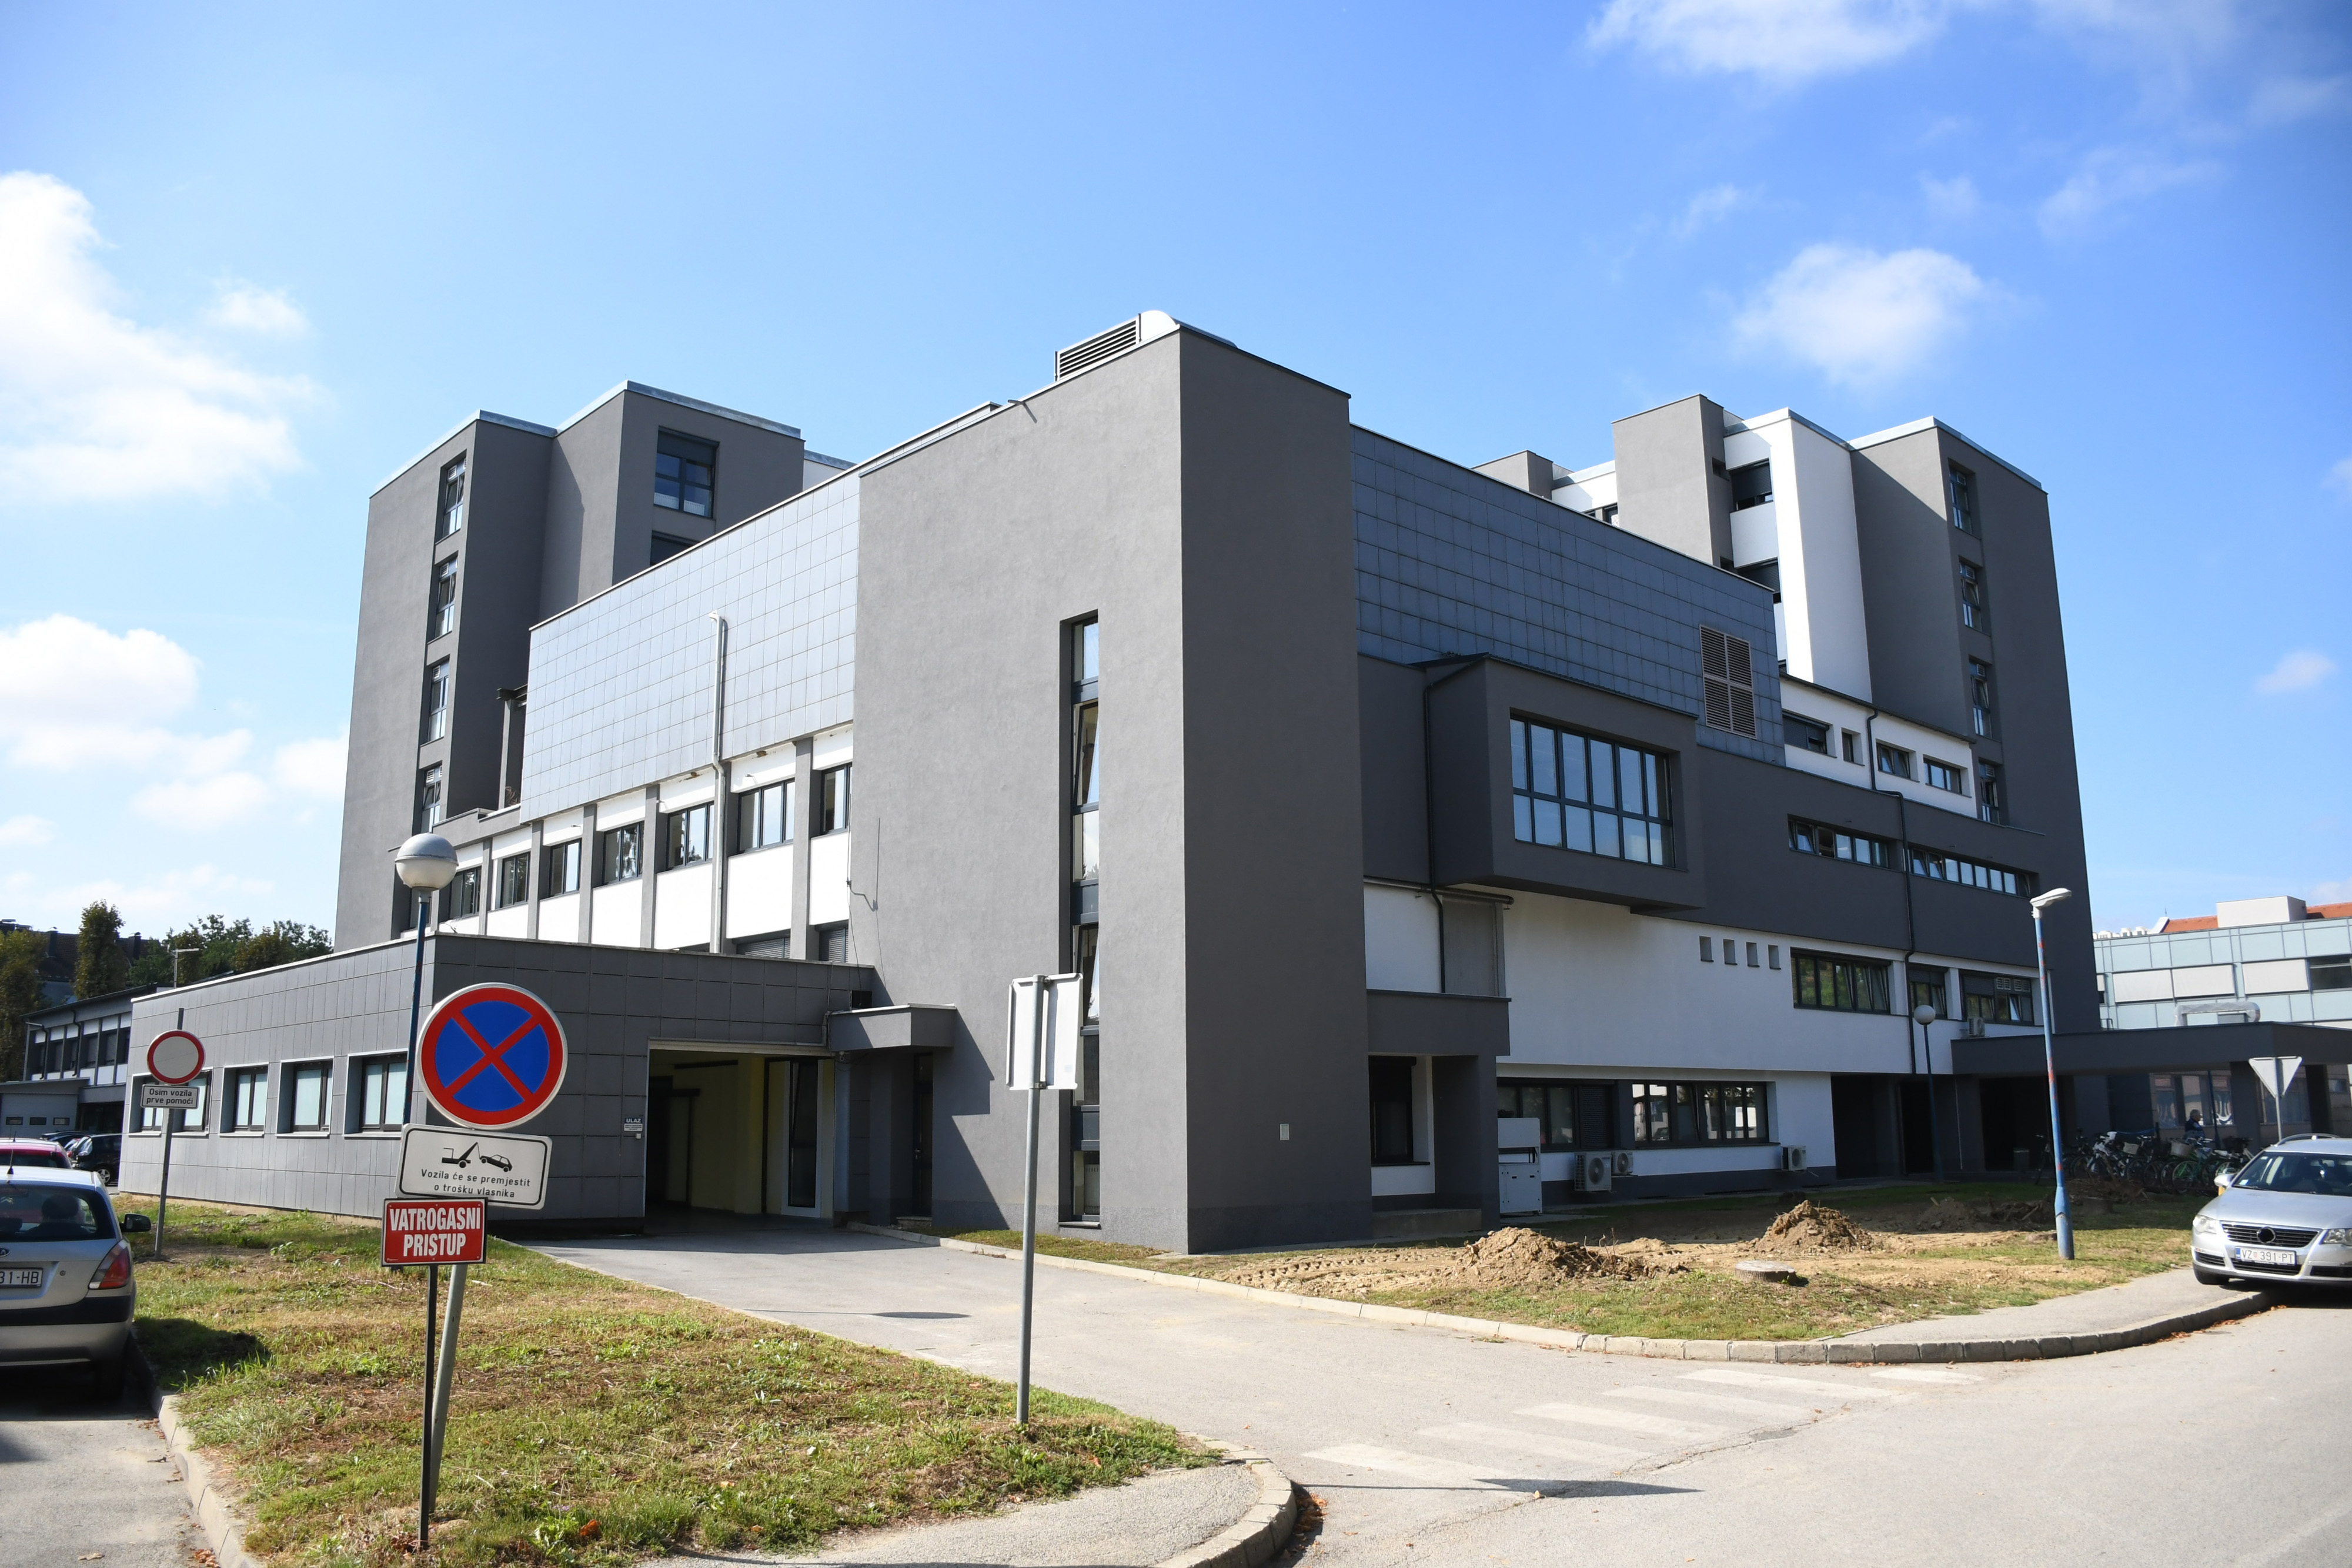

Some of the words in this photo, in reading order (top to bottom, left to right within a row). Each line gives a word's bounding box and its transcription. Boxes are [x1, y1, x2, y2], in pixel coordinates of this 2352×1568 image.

[421, 1169, 449, 1179] Vozila
[453, 1172, 463, 1181] će
[480, 1176, 530, 1186] premjestit
[443, 1184, 473, 1194] trošku
[477, 1188, 515, 1198] vlasnika
[389, 1207, 481, 1231] VATROGASNI
[403, 1233, 466, 1256] PRISTUP
[2242, 1250, 2252, 1259] VZ
[2260, 1251, 2293, 1263] 391-PT
